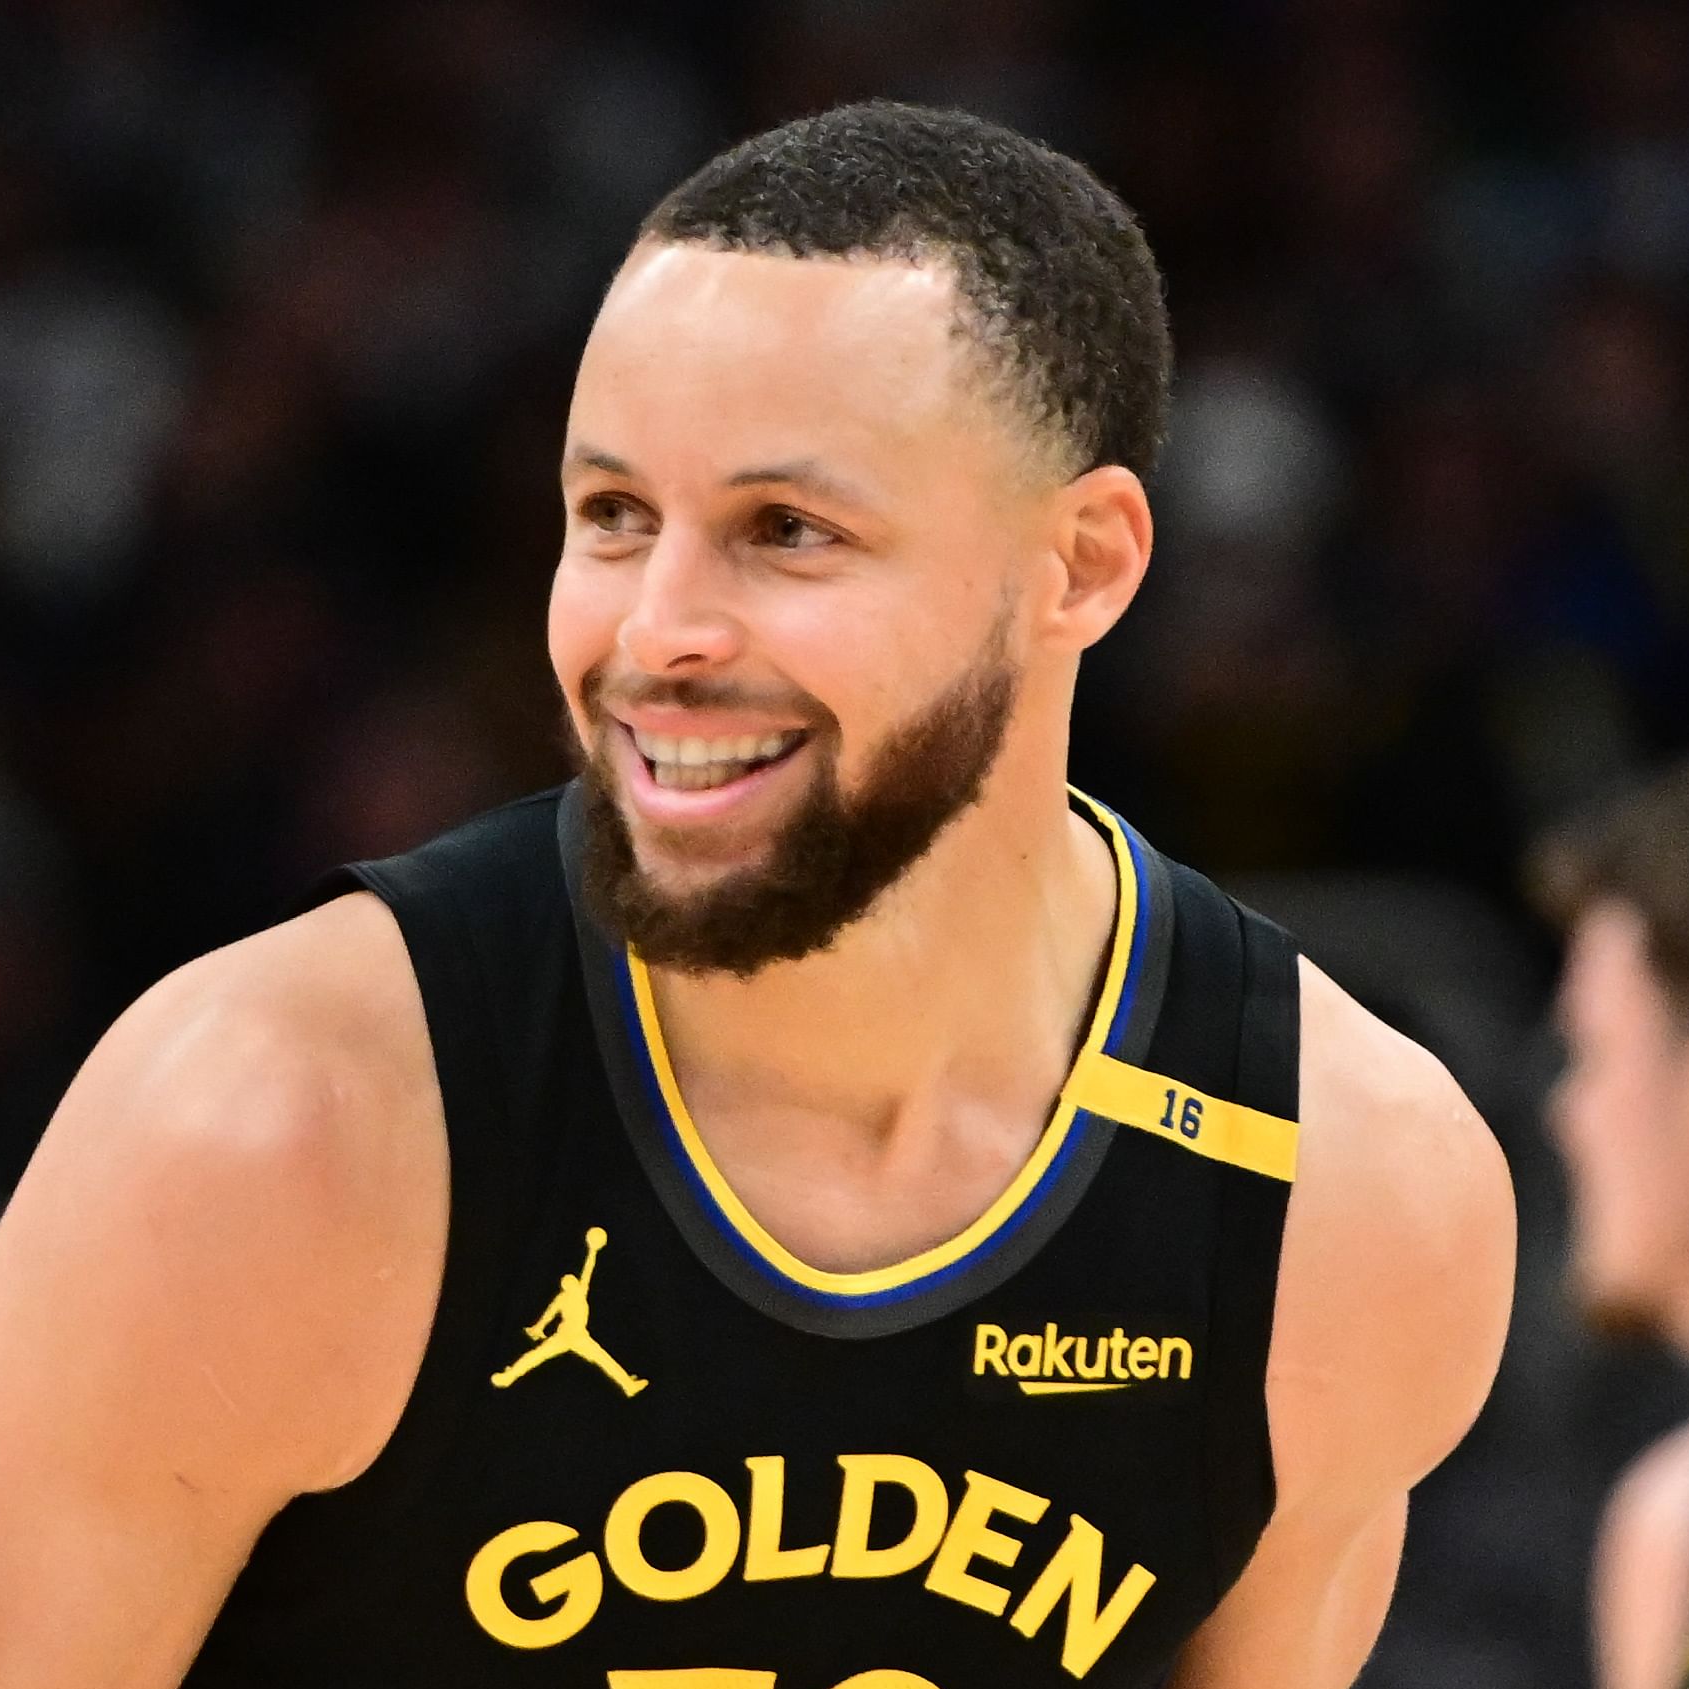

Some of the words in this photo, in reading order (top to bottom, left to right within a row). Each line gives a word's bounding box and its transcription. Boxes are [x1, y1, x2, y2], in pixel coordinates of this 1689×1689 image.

[1160, 1088, 1203, 1140] 16
[973, 1322, 1193, 1380] Rakuten
[465, 1453, 1157, 1680] GOLDEN
